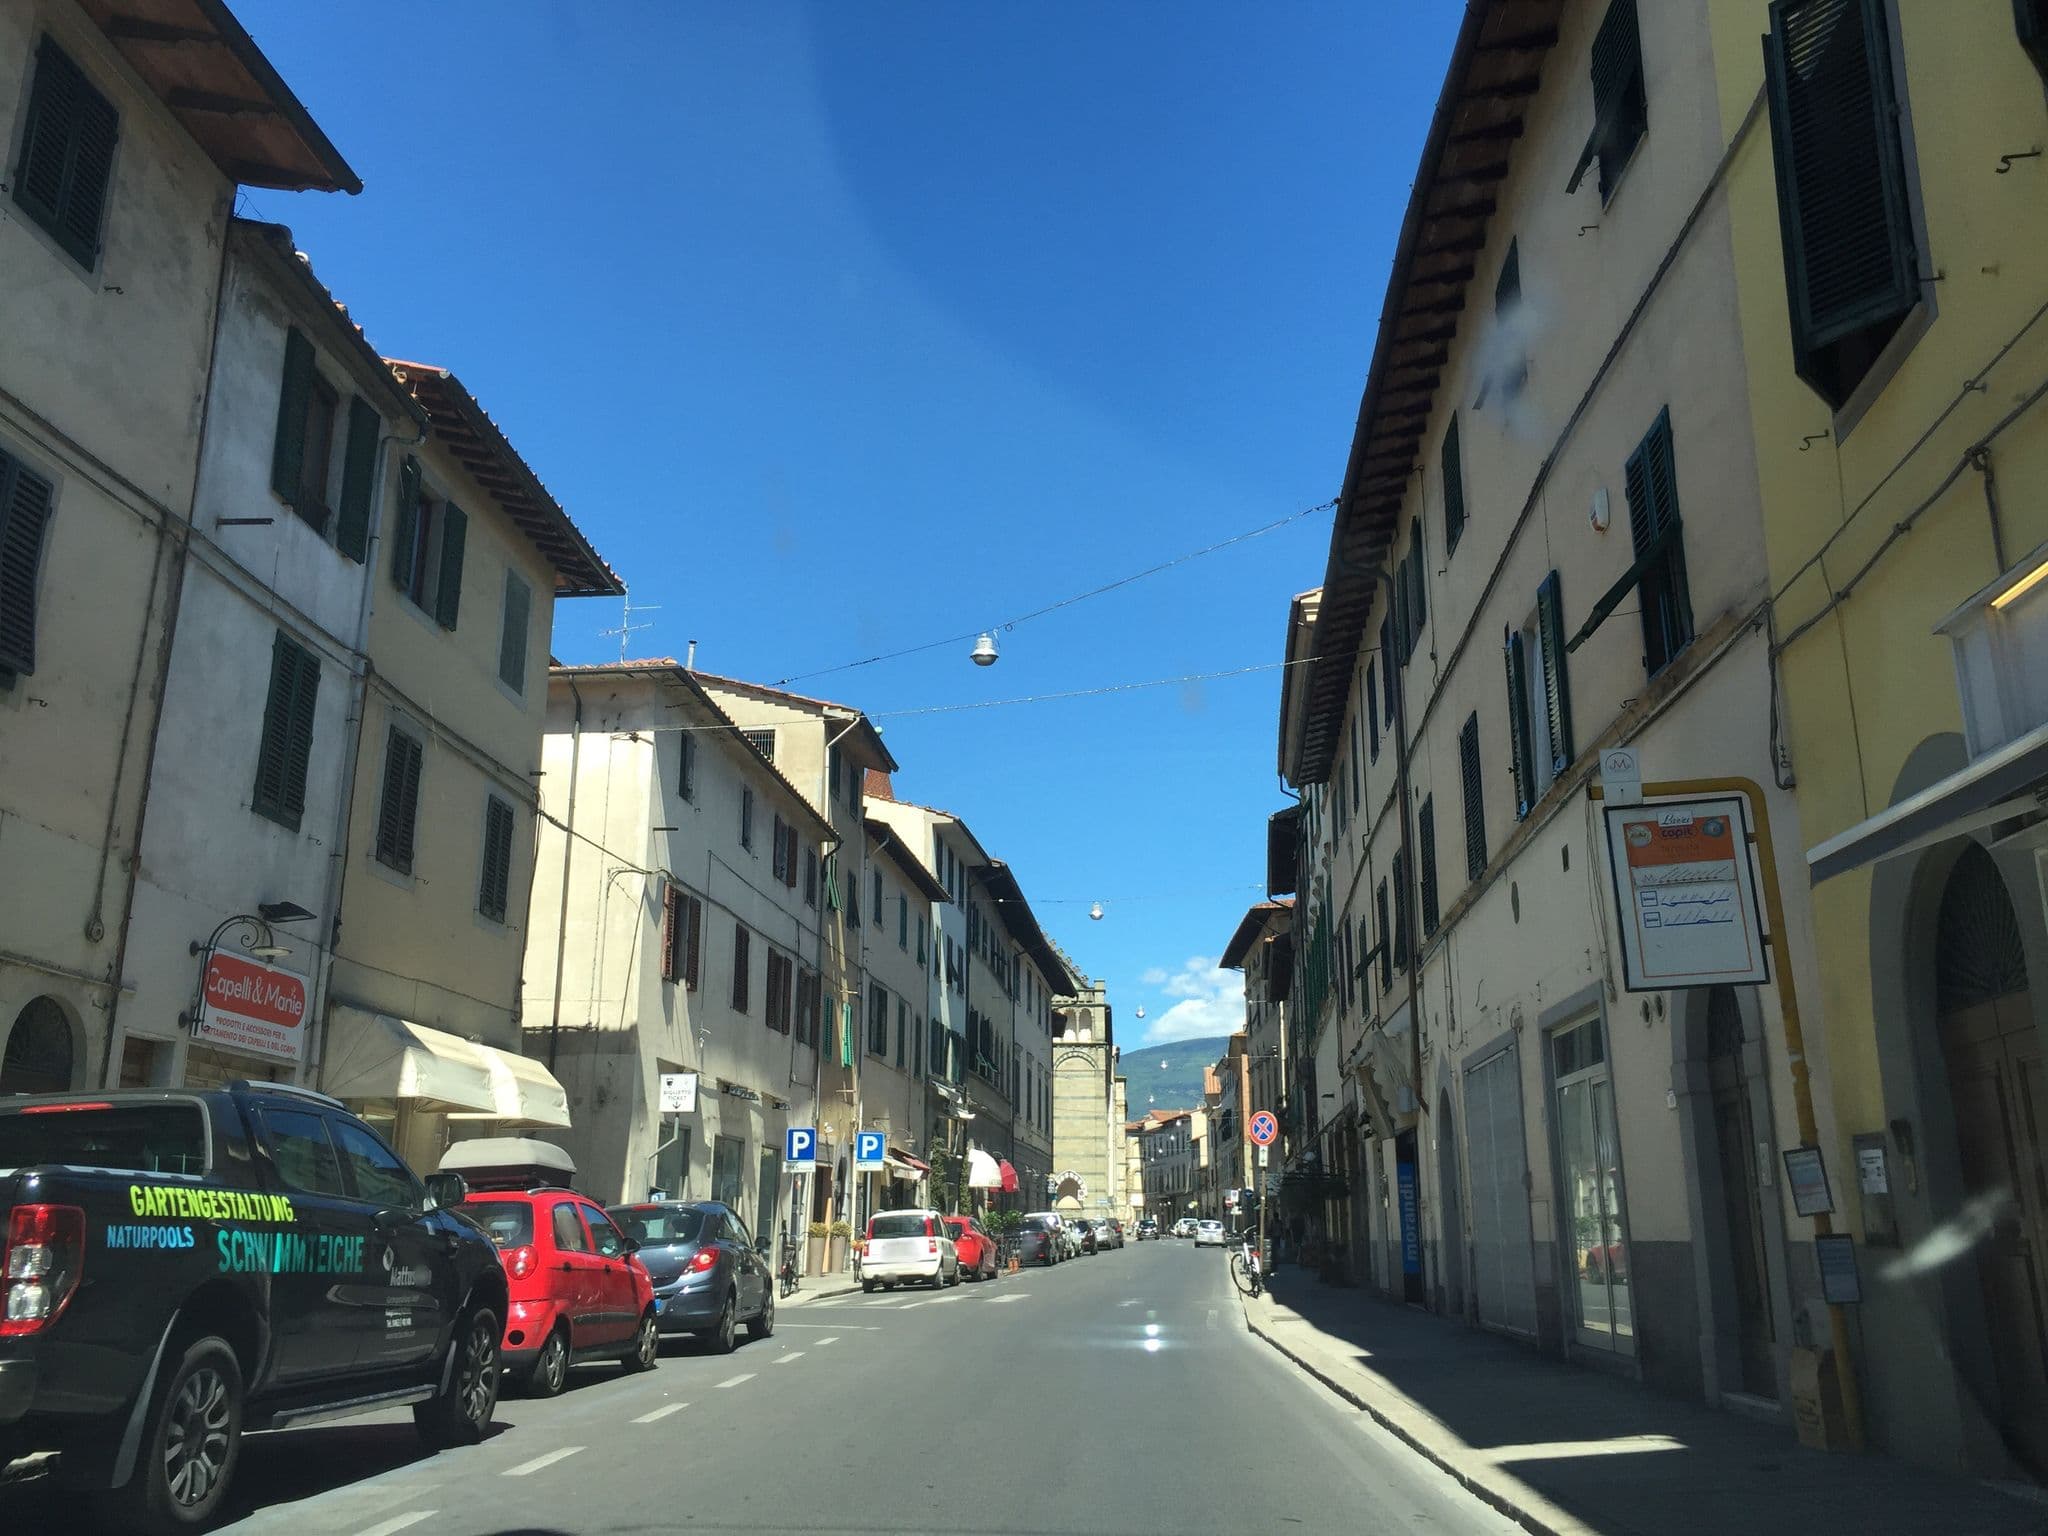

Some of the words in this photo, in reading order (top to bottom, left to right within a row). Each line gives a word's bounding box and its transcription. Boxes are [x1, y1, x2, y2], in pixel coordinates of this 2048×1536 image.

[208, 967, 252, 1001] Capelli
[252, 976, 264, 1005] &
[264, 983, 302, 1016] Manie
[792, 1131, 810, 1158] P
[862, 1135, 878, 1158] P
[107, 1224, 195, 1249] NATURPOOLS
[217, 1230, 365, 1273] SCHWIMMTEICHE
